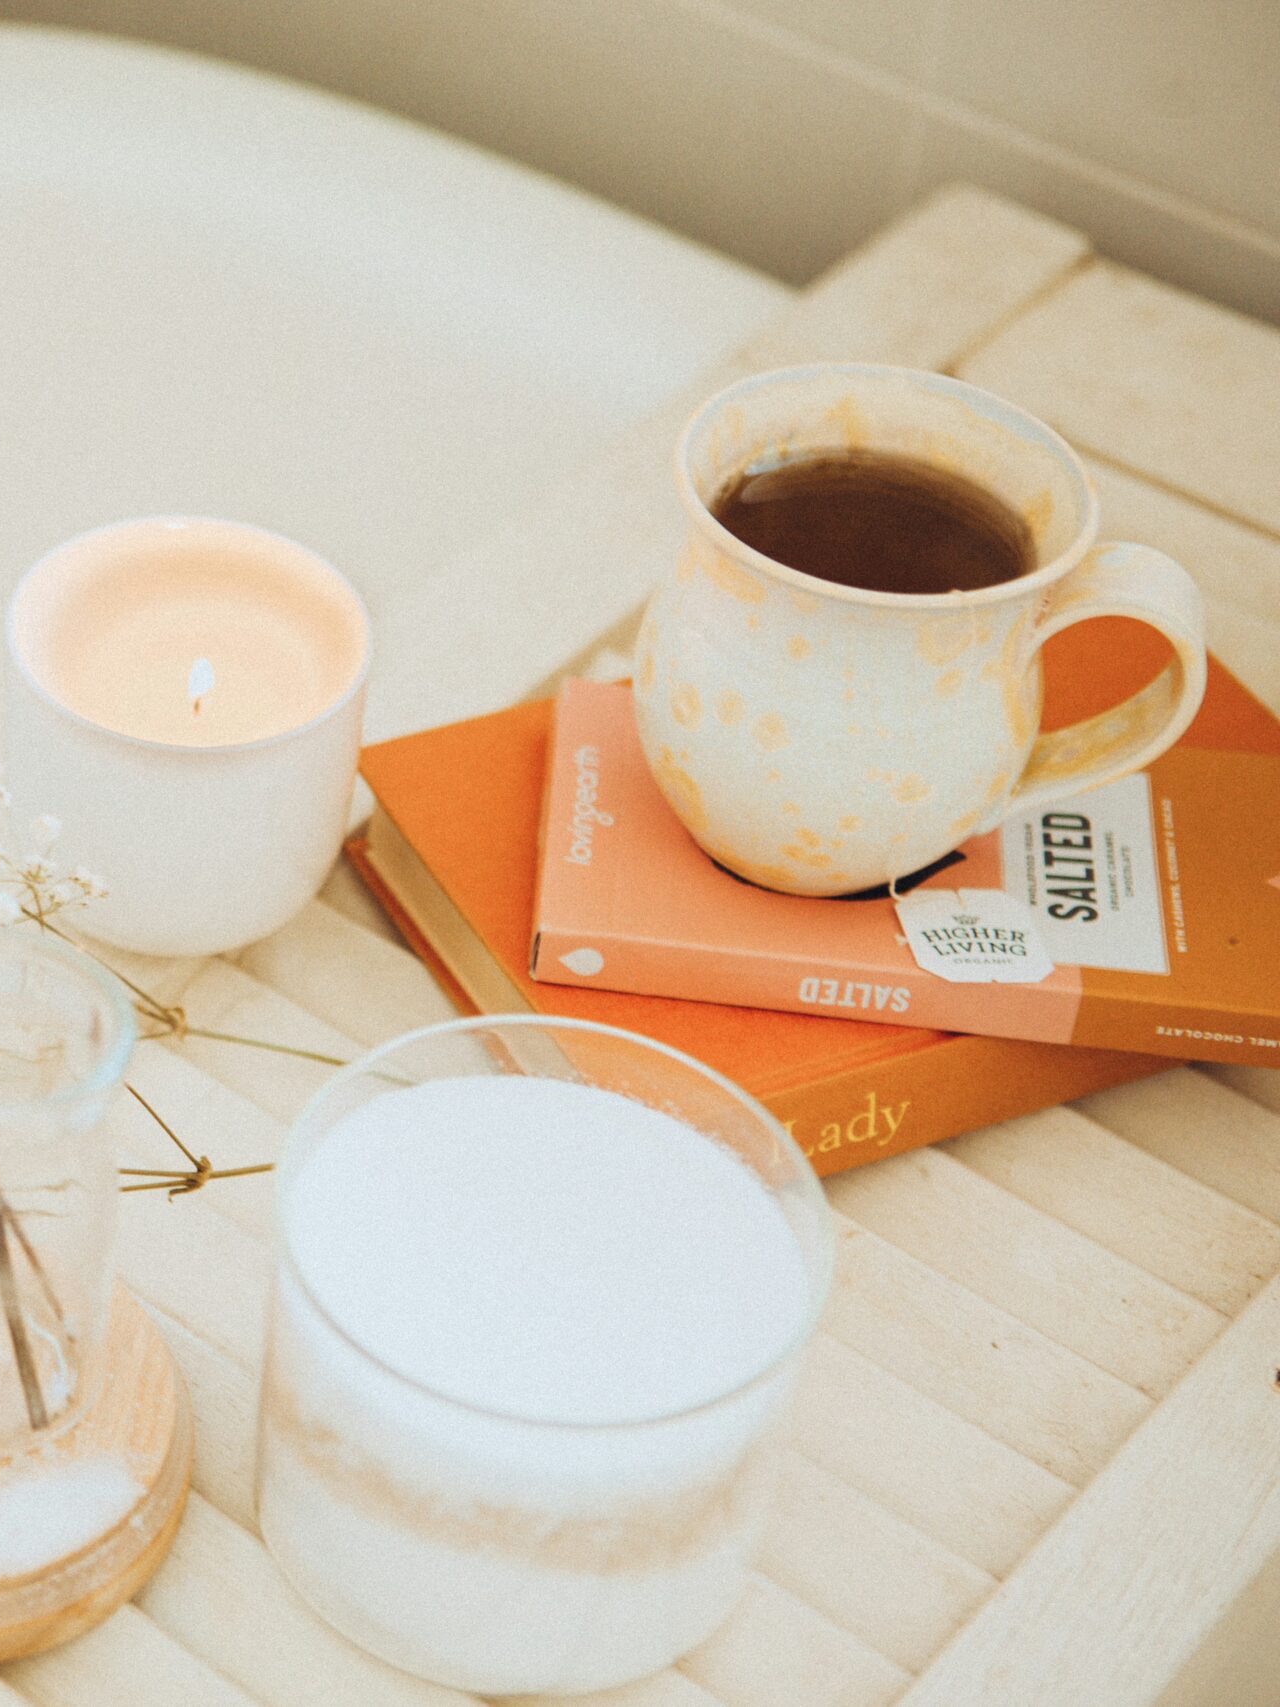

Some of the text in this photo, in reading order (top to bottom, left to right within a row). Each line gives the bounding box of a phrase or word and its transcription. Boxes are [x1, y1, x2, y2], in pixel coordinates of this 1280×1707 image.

[1042, 812, 1099, 923] SALTED
[921, 927, 1026, 943] HIGHER
[1175, 929, 1188, 953] WITH
[932, 942, 1028, 957] LIVING
[953, 957, 1015, 965] ORGANIC
[799, 976, 912, 1013] SALTED
[1155, 1026, 1280, 1049] MEL CHOCOLATE
